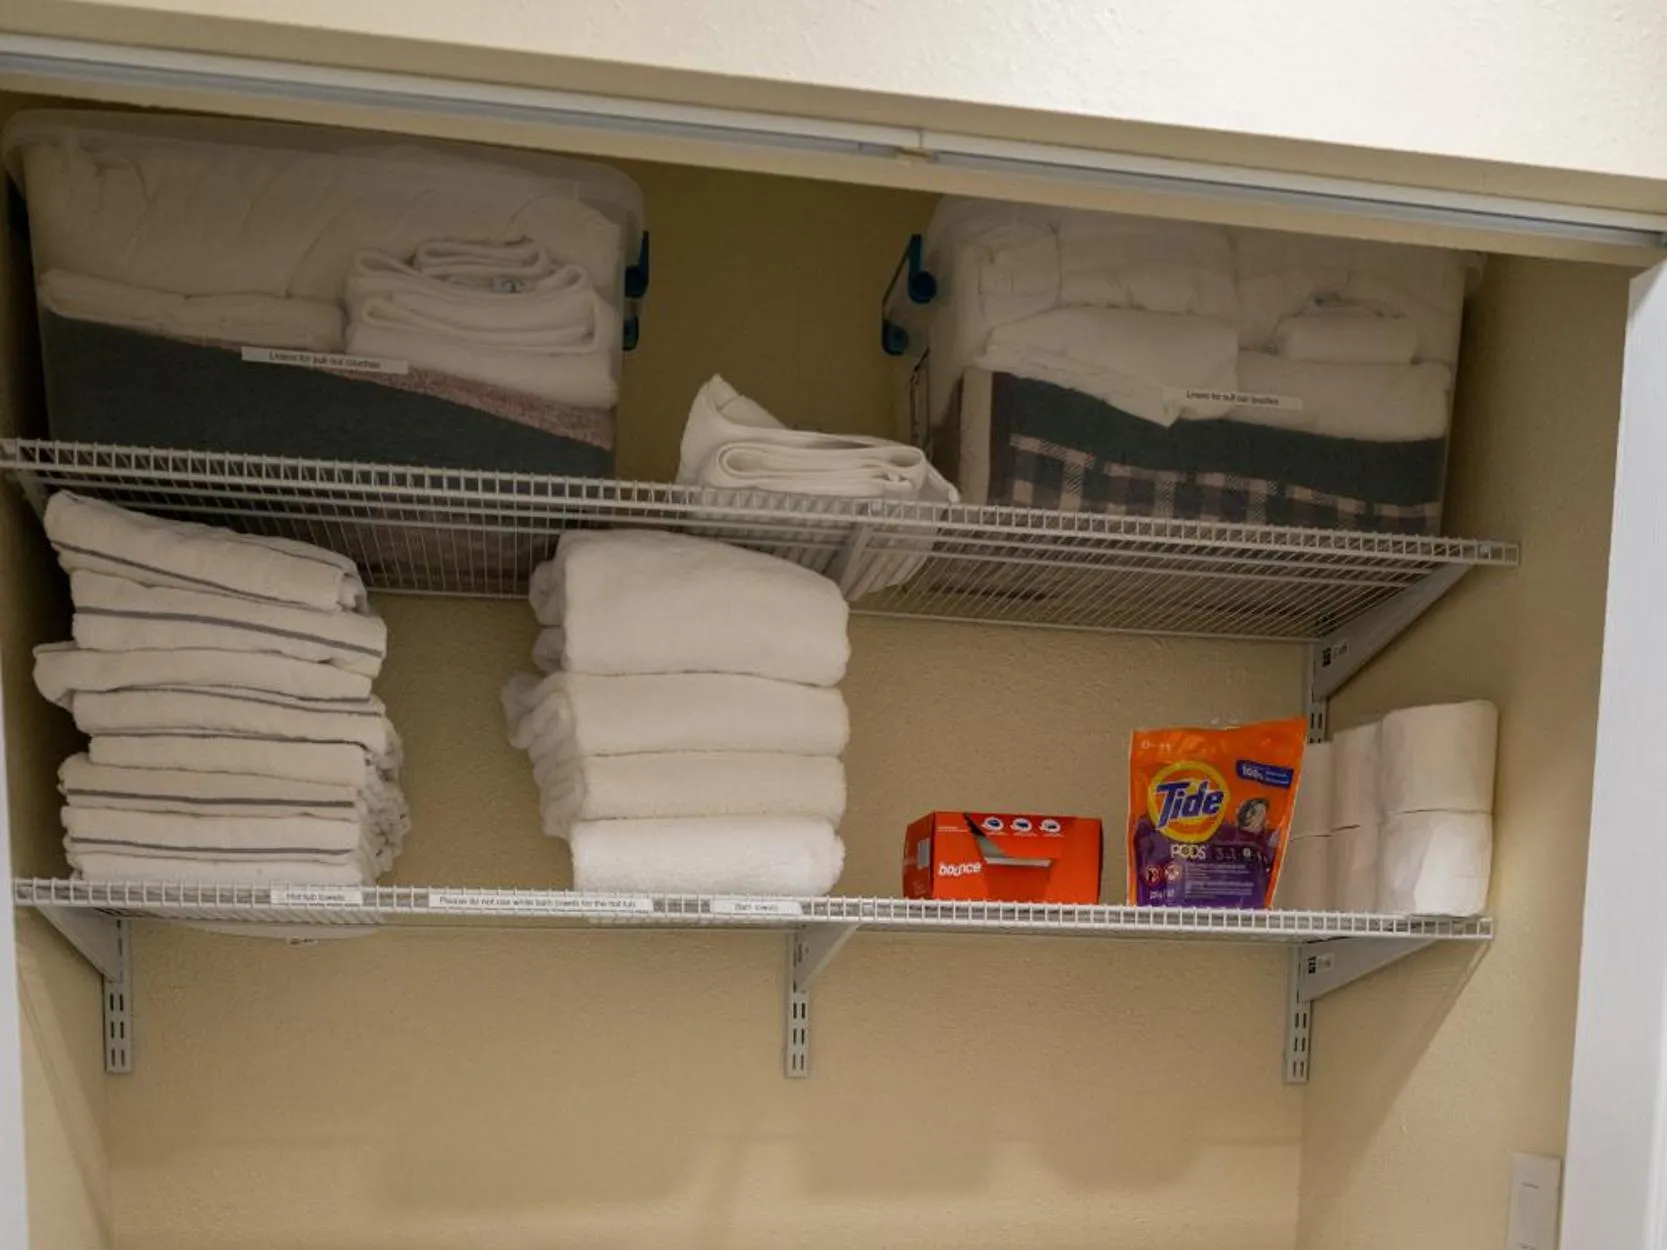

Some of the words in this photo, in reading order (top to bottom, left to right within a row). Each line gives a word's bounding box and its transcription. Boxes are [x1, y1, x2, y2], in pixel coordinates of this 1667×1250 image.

[1155, 778, 1225, 830] Tide
[1170, 844, 1207, 861] PODS
[939, 861, 982, 876] bounce
